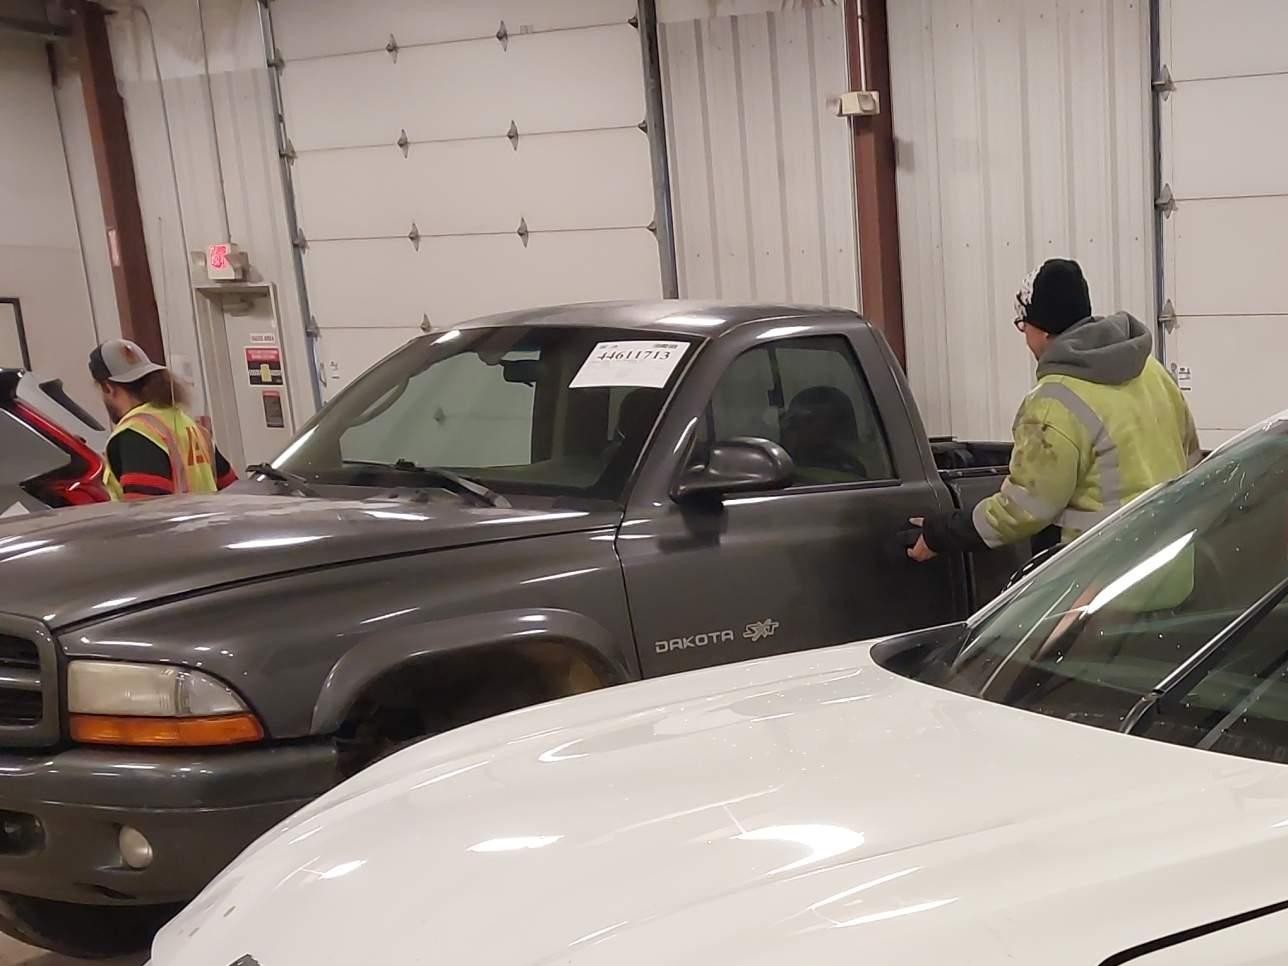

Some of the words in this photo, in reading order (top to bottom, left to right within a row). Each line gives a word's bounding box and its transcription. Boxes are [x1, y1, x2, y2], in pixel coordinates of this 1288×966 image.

[597, 350, 671, 361] 44611713
[655, 629, 735, 654] DAKOTA
[743, 618, 780, 642] SXT
